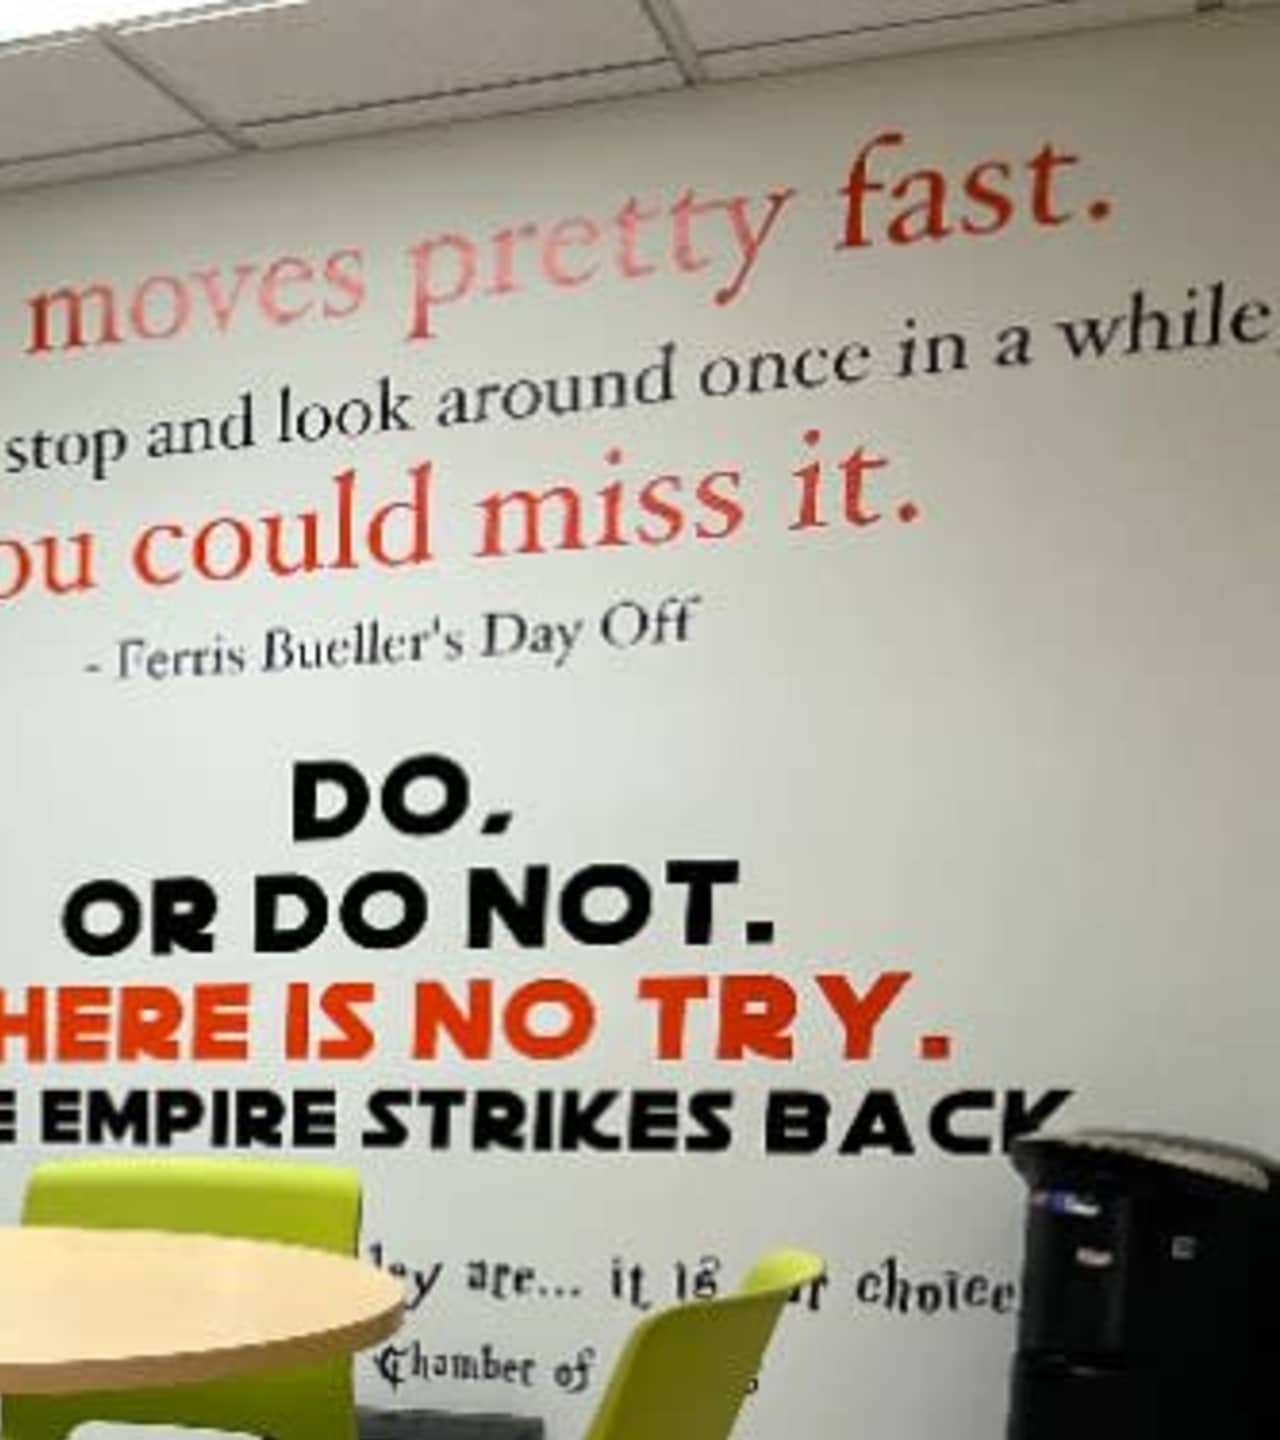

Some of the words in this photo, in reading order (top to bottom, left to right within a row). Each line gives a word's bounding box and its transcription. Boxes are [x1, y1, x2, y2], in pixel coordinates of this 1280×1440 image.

[24, 244, 367, 358] moves
[404, 184, 796, 344] pretty
[834, 130, 1114, 252] fast.
[4, 424, 128, 482] stop
[146, 394, 254, 458] and
[279, 377, 412, 444] look
[436, 341, 676, 427] around
[698, 344, 872, 399] once
[896, 318, 970, 378] in
[994, 320, 1034, 366] a
[131, 460, 434, 587] could
[470, 448, 746, 558] miss
[786, 428, 922, 532] it.
[116, 638, 246, 681] Ferris
[260, 616, 464, 674] Bueller's
[480, 611, 584, 668] Day
[600, 596, 702, 648] Off
[292, 753, 512, 842] DO,
[61, 876, 218, 957] OR
[253, 869, 429, 954] DO
[466, 859, 774, 949] NOT.
[285, 981, 376, 1061] IS
[412, 977, 596, 1061] NO
[638, 970, 951, 1061] TRY.
[41, 1089, 338, 1148] EMPIRE
[361, 1090, 734, 1150] STRIKES
[765, 1090, 1075, 1154] BACK
[613, 1256, 652, 1308] it
[373, 1341, 536, 1394] Chamber
